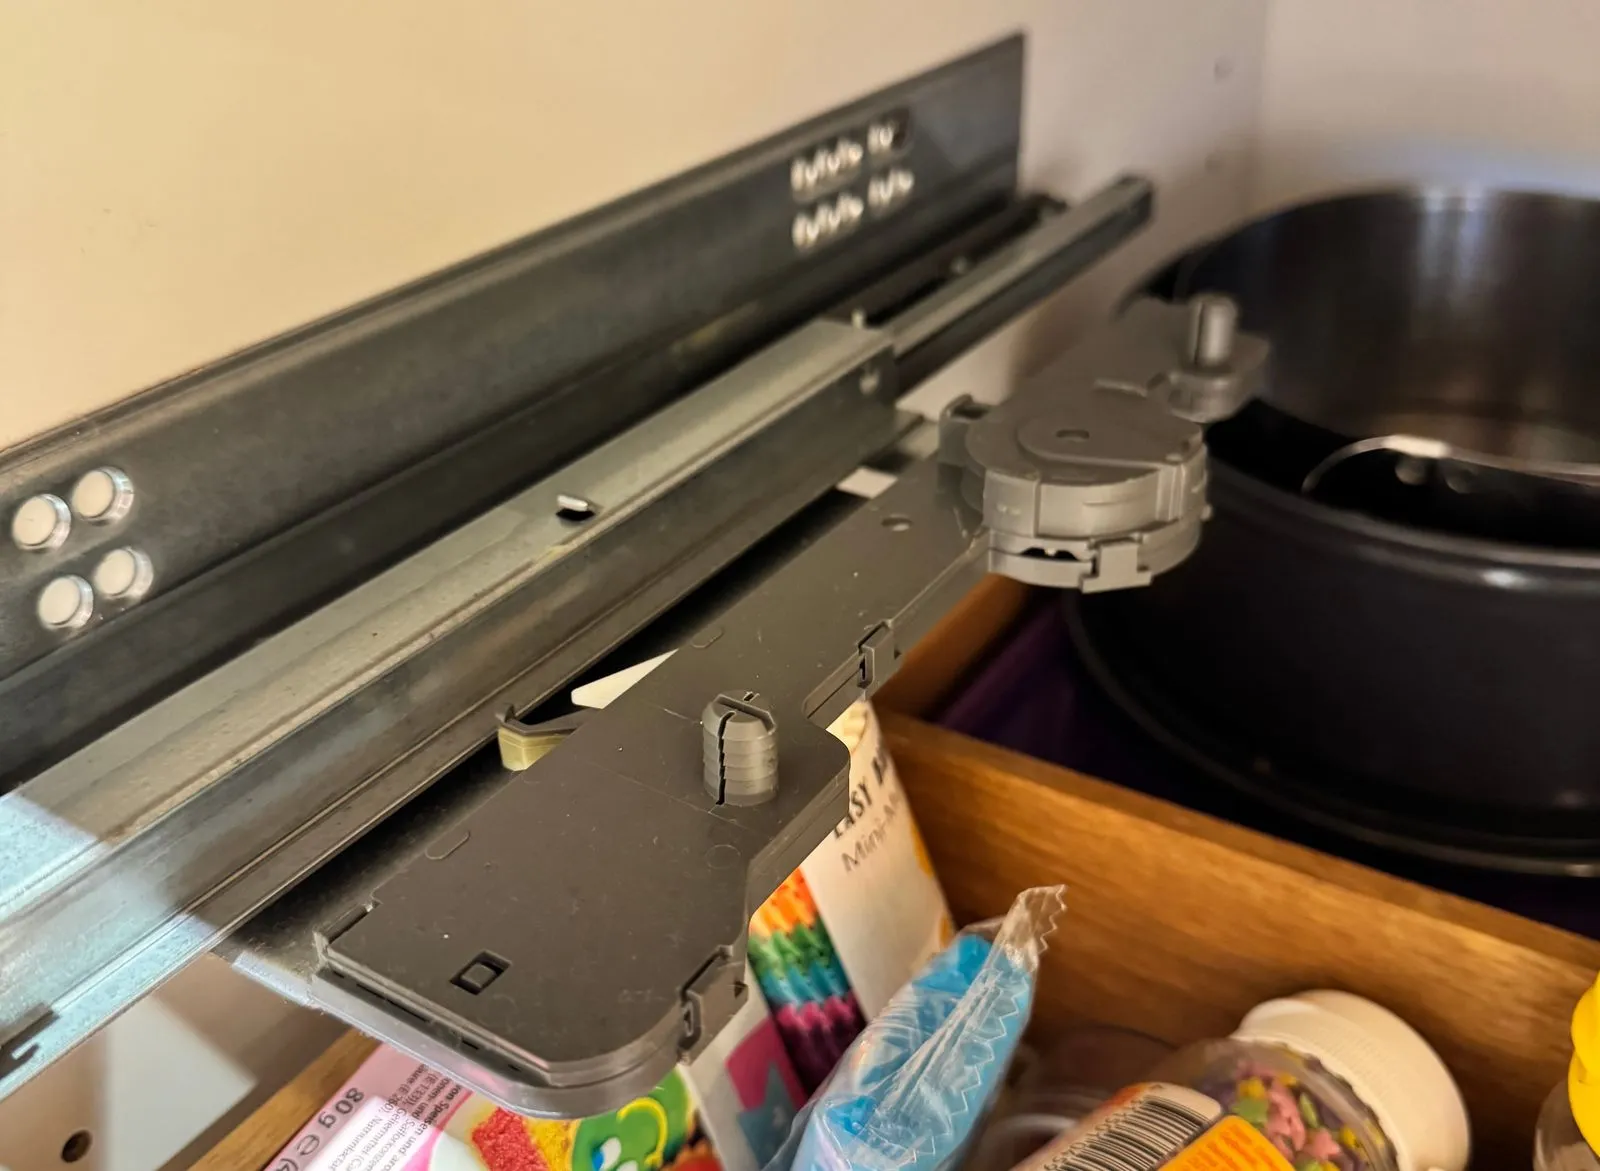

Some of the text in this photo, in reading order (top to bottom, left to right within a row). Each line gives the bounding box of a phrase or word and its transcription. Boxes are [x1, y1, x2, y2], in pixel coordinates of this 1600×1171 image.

[335, 1087, 364, 1114] 80
[318, 1110, 337, 1128] g
[411, 1102, 428, 1120] und
[415, 1100, 450, 1136] Speisen
[400, 1136, 417, 1156] und
